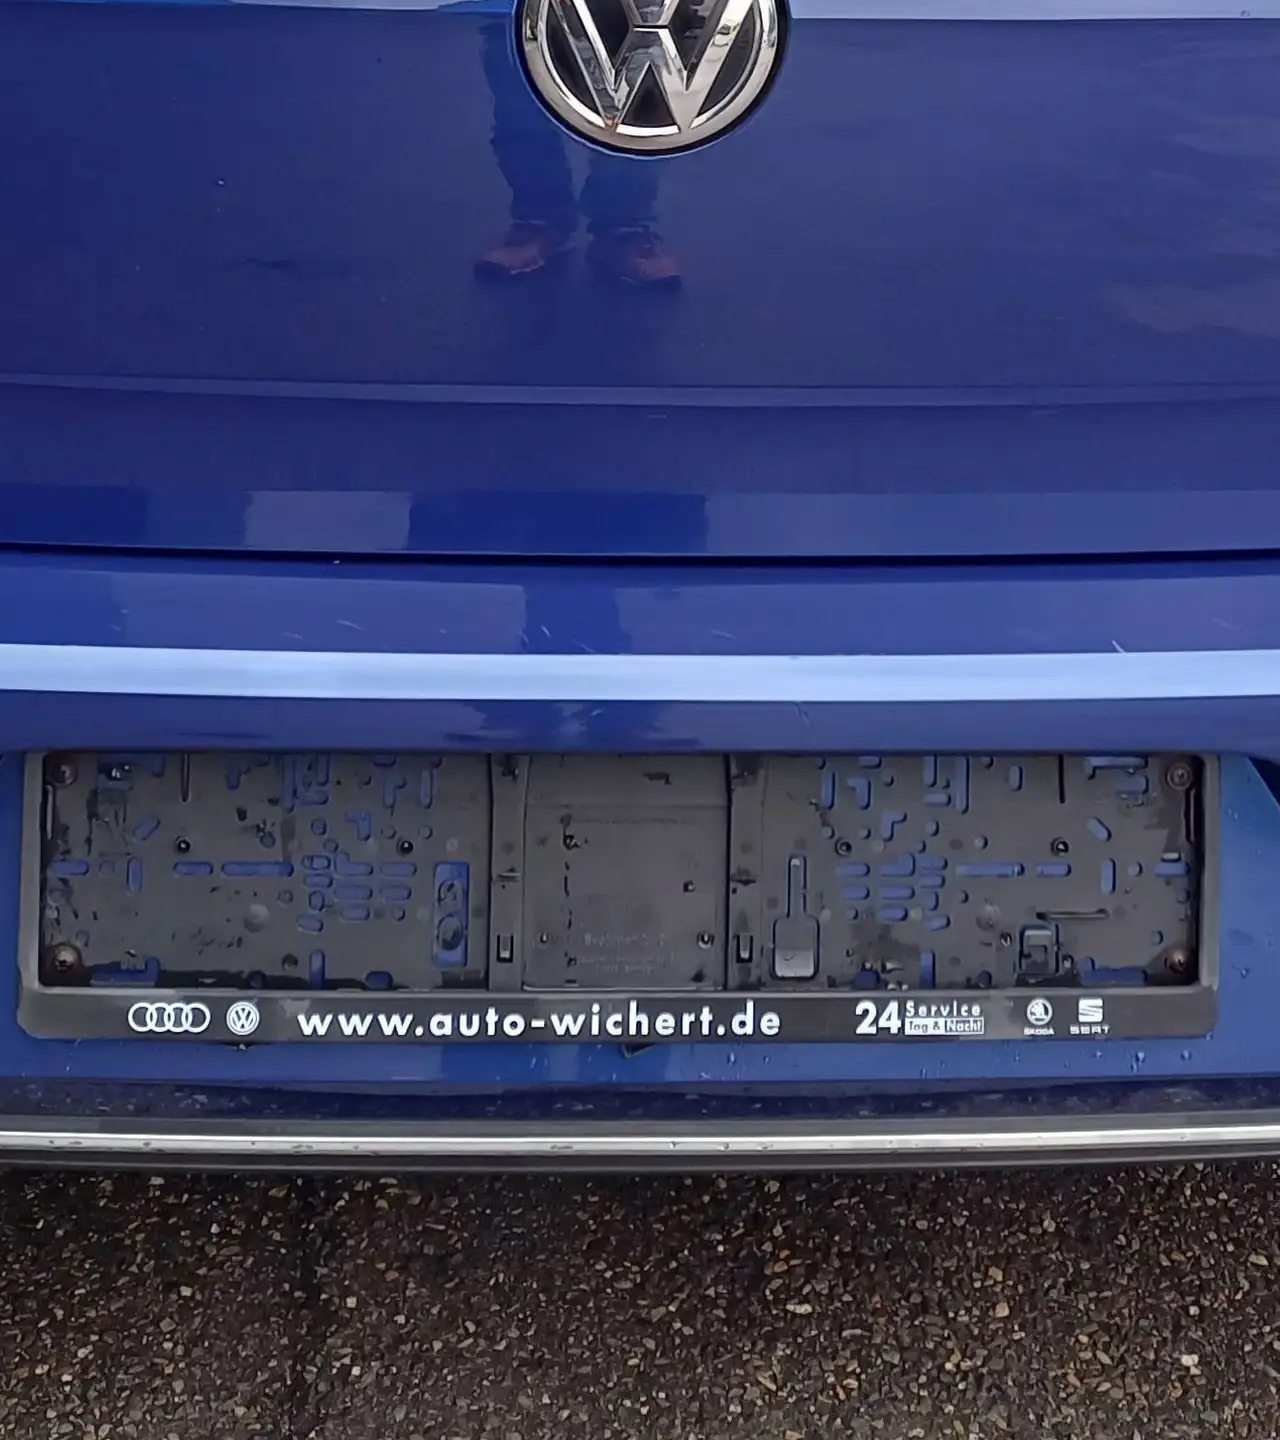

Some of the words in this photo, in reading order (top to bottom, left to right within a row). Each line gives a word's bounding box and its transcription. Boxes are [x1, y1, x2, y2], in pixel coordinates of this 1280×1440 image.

[297, 1000, 782, 1037] www.auto-wichert.de
[855, 1000, 902, 1034] 24
[905, 1000, 981, 1017] Service
[908, 1020, 928, 1034] Tag
[933, 1020, 941, 1031] &
[946, 1020, 983, 1033] Nacht
[1069, 1024, 1110, 1035] SEAT
